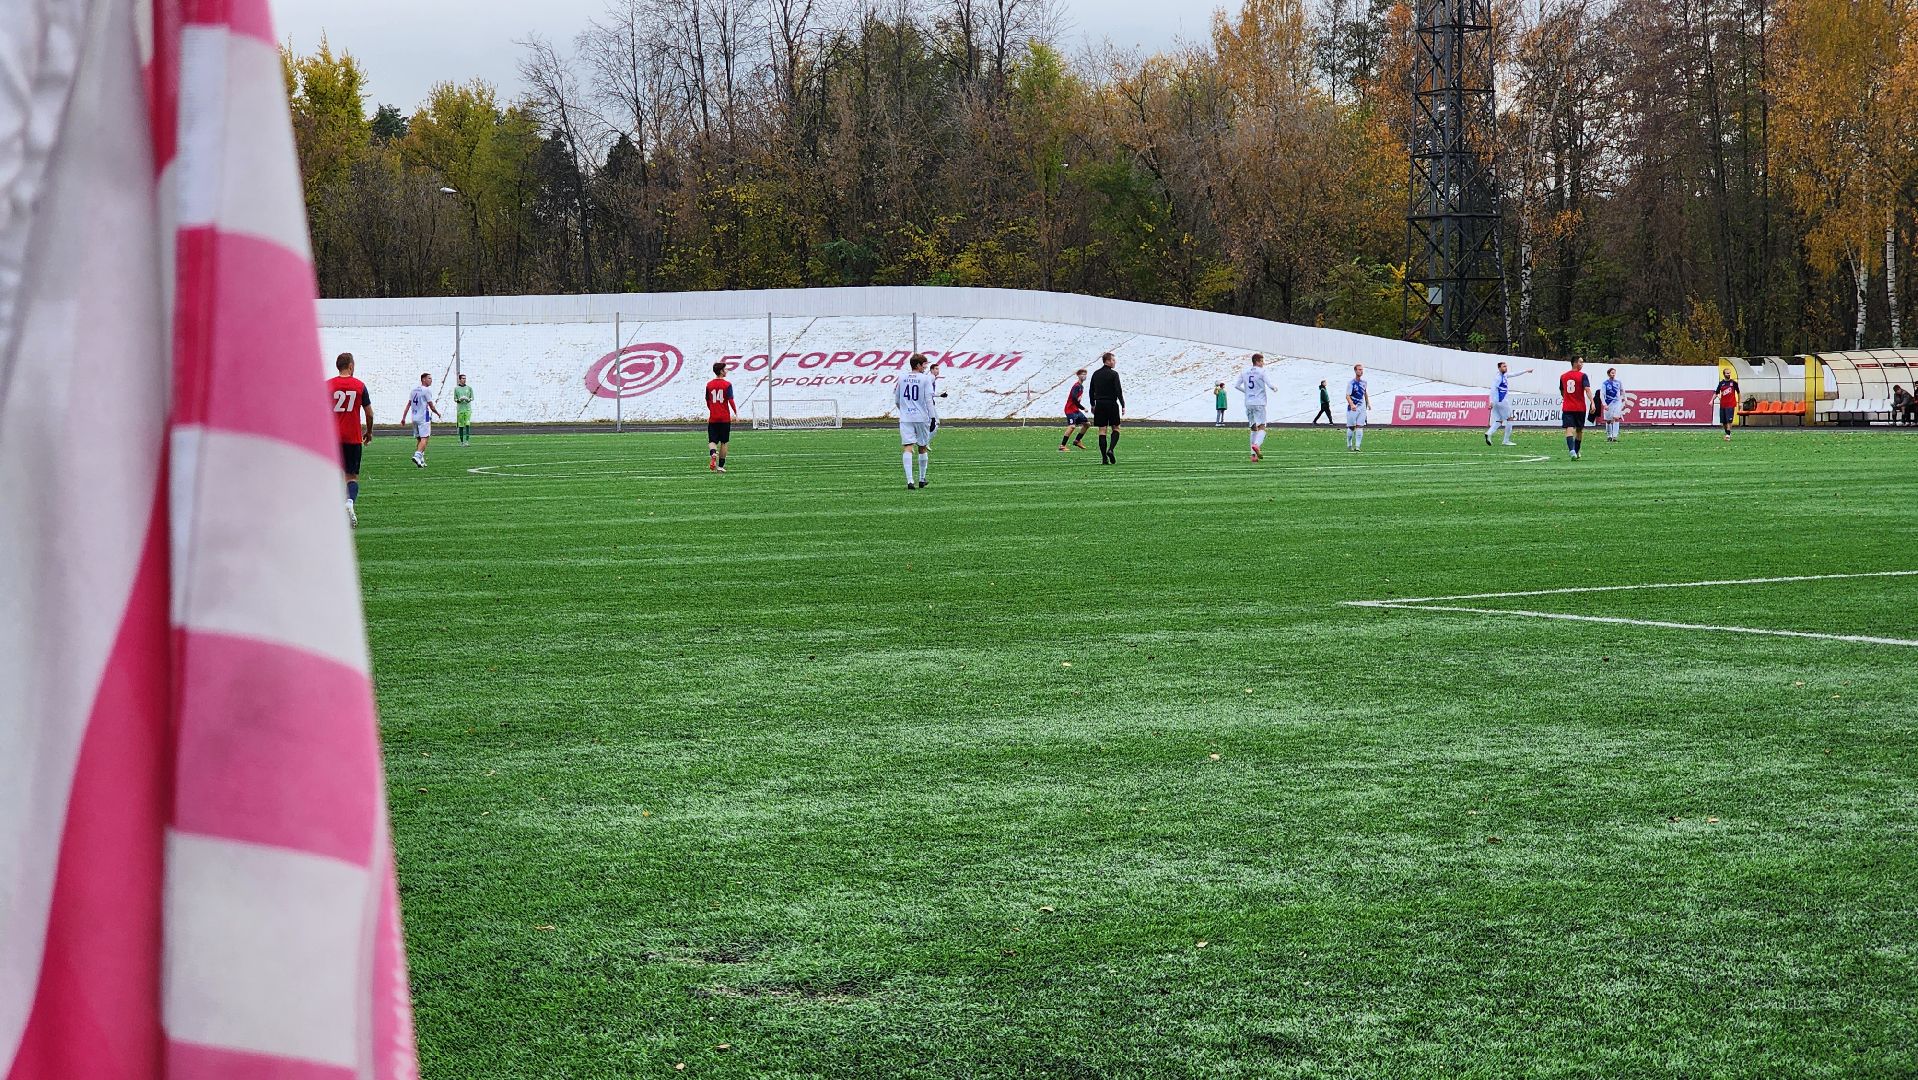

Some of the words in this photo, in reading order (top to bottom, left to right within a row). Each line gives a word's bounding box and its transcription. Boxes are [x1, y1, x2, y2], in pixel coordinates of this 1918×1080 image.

[756, 374, 878, 387] ГОРОДСКОЙ
[1248, 375, 1255, 390] 5
[1566, 379, 1576, 394] 8
[711, 389, 724, 404] 14
[903, 384, 919, 401] 40
[333, 390, 357, 412] 27
[412, 393, 418, 406] 4
[1417, 401, 1444, 409] ПРЯМЫЕ
[1445, 401, 1486, 410] ТРАНСЛЯЦИИ
[1511, 397, 1541, 406] БИЛЕТЫ
[1639, 397, 1684, 407] ЗНАМЯ
[1426, 410, 1457, 421] Znamya
[1458, 410, 1469, 419] TV
[1638, 409, 1696, 419] ТЕЛЕКОМ
